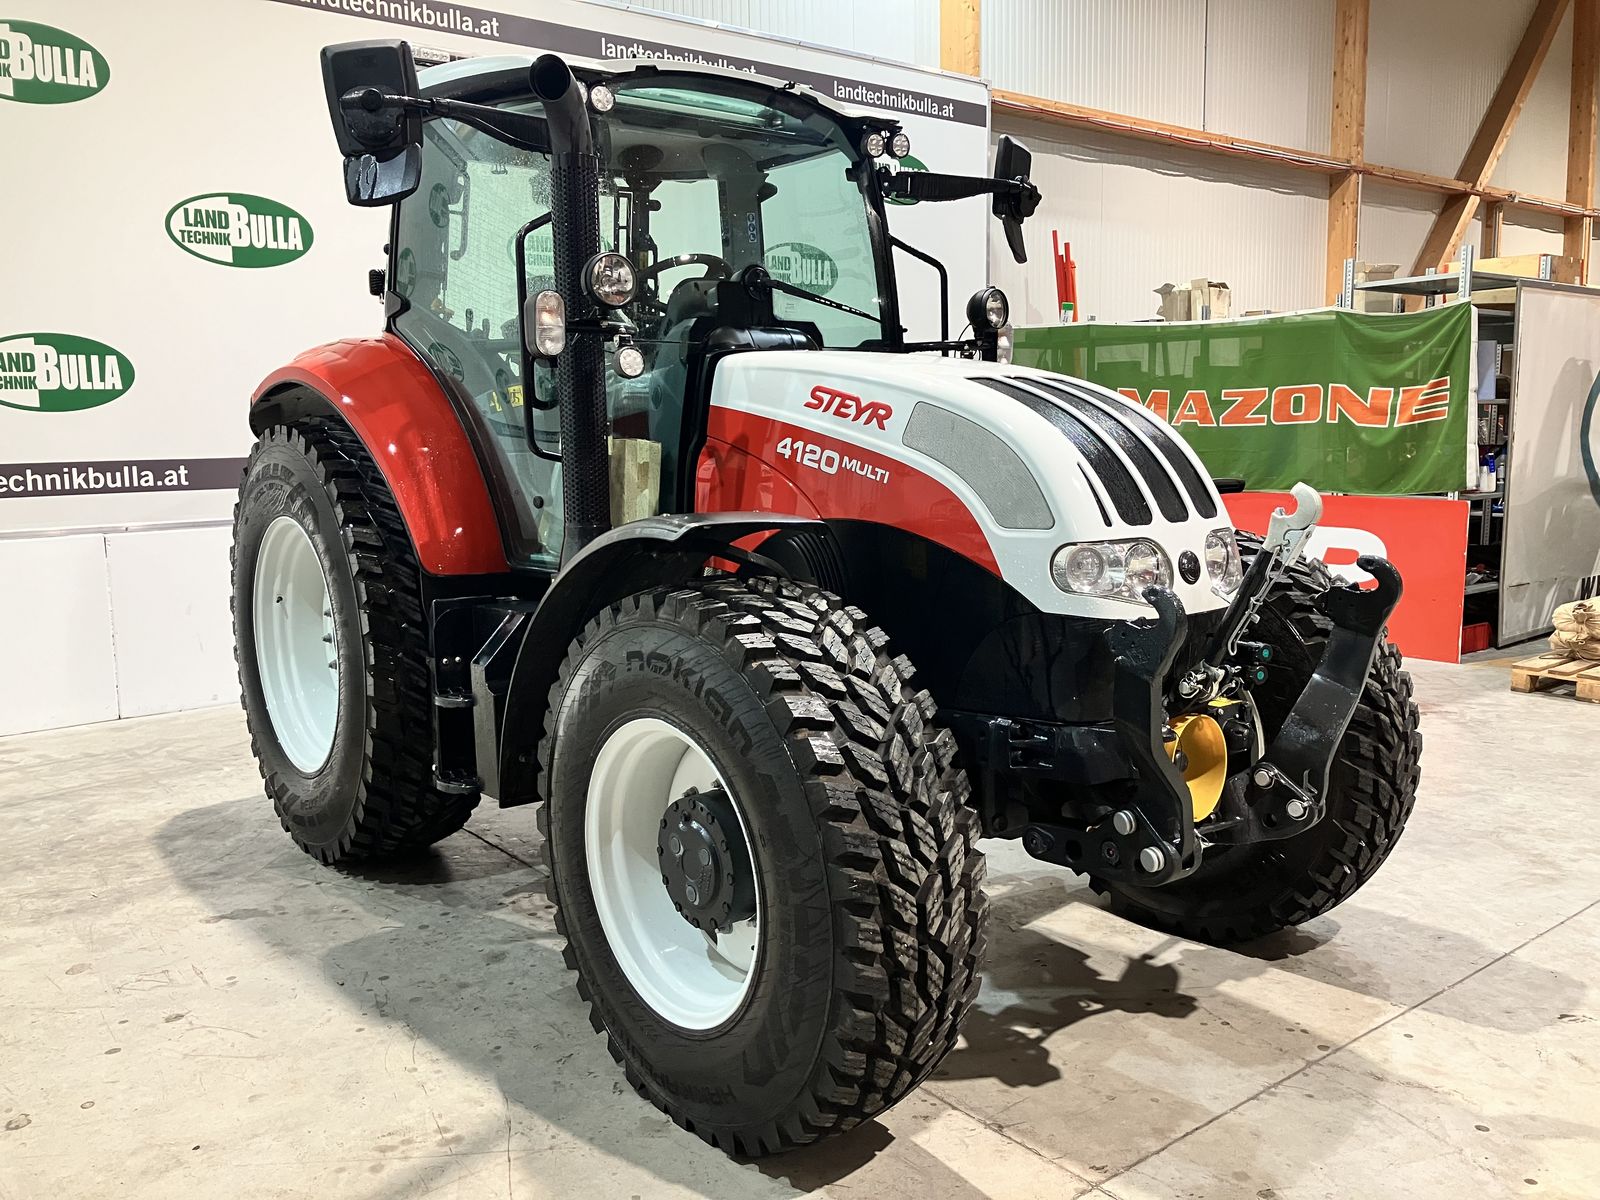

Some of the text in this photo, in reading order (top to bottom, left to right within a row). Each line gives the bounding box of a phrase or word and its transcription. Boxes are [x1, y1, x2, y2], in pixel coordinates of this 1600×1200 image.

[10, 32, 98, 88] BULLA
[833, 80, 954, 118] landtechnikbulla.at
[179, 229, 231, 246] TECHNIK
[183, 207, 230, 230] LAND
[229, 203, 304, 251] BULLA
[35, 344, 123, 391] BULLA
[804, 385, 893, 431] STEYR
[776, 437, 890, 484] 4120 MULTI
